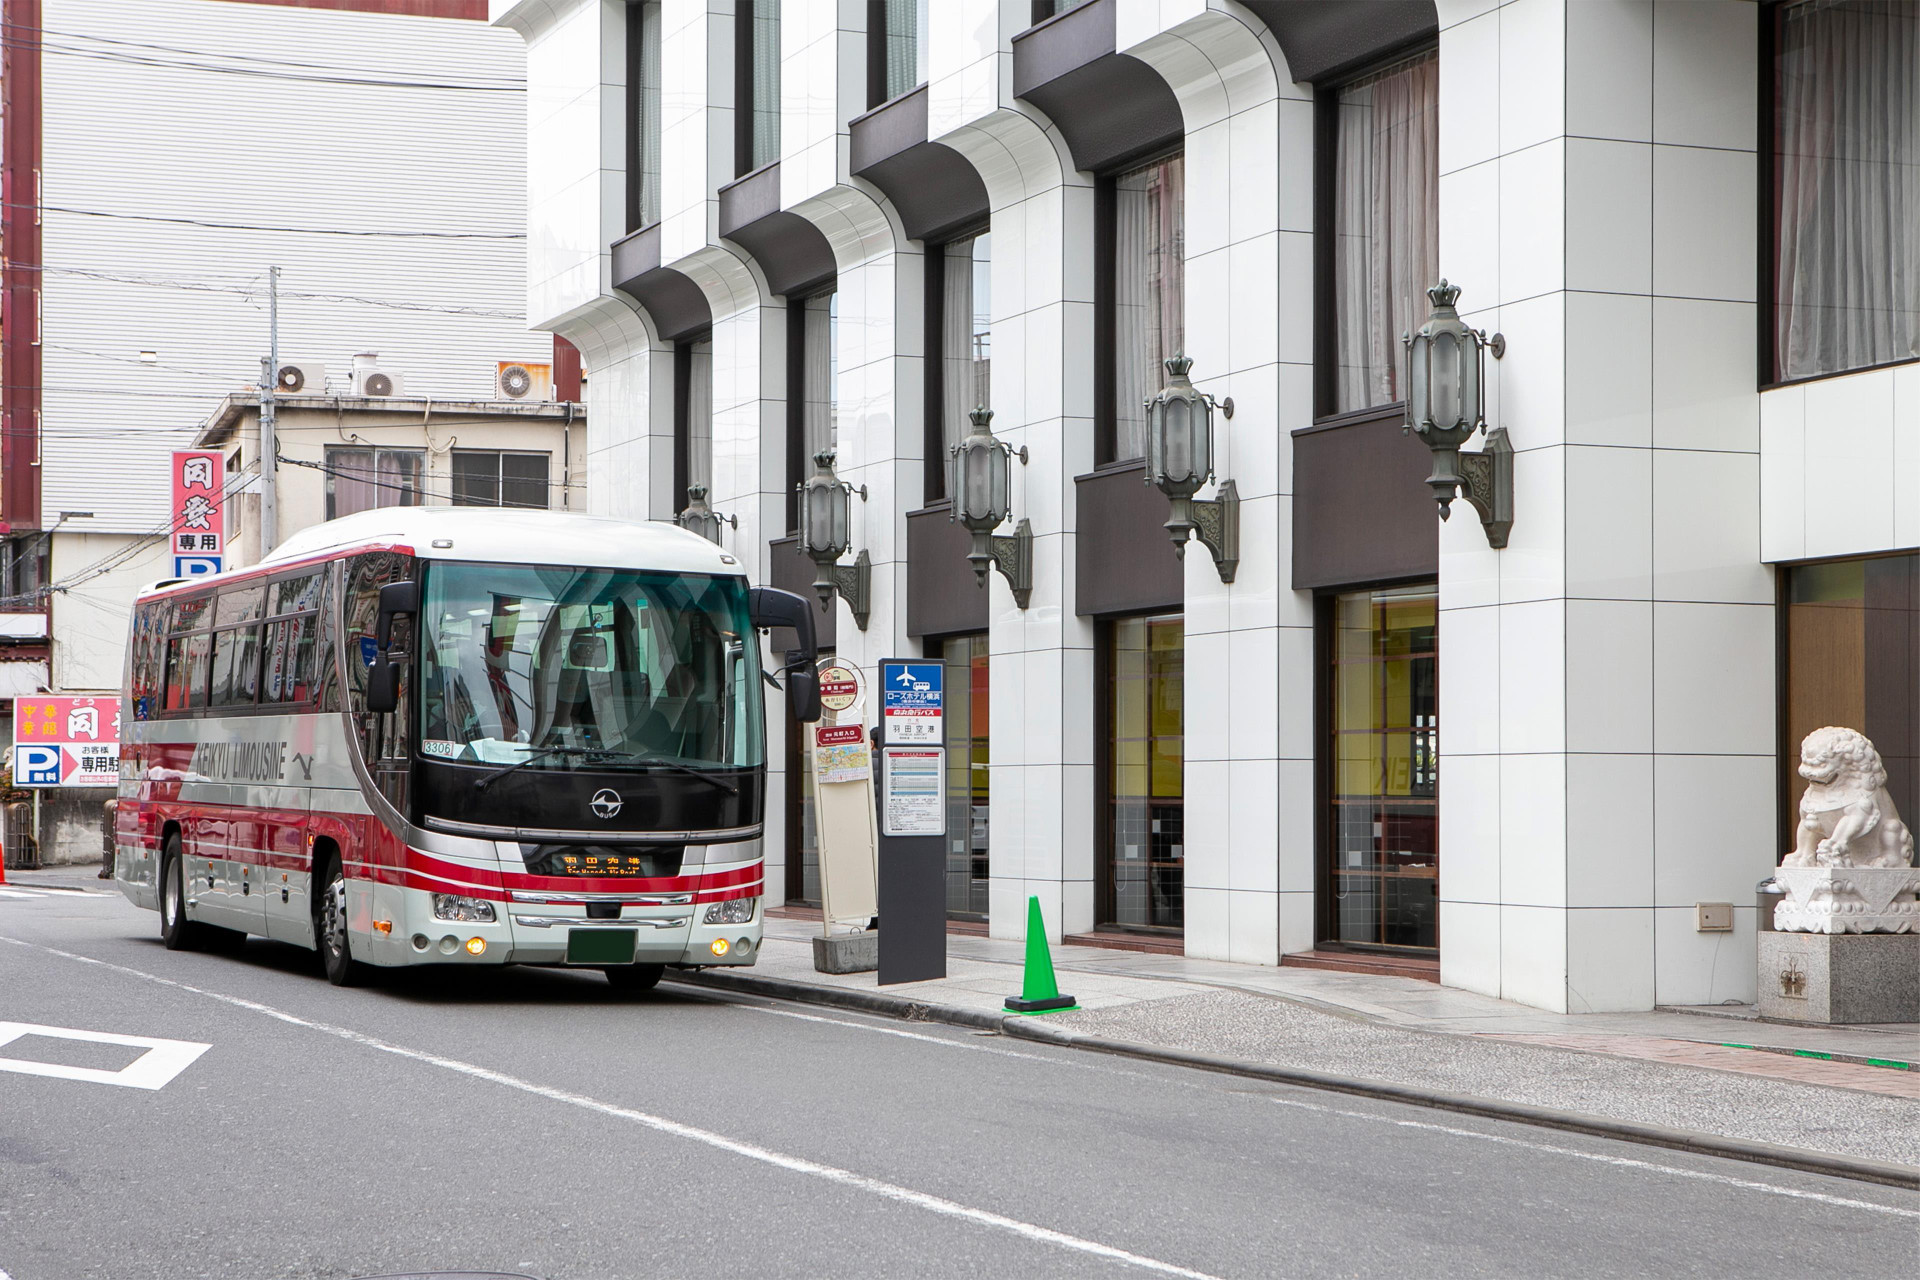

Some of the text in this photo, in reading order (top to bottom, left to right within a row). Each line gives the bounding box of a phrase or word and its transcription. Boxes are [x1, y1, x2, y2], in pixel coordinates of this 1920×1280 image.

[179, 534, 217, 551] 専用
[180, 558, 218, 579] P
[887, 693, 941, 701] ローズホテル横浜
[893, 724, 935, 734] 羽田空港
[82, 747, 109, 755] お客様
[425, 742, 451, 754] 3306
[17, 747, 59, 783] P
[81, 757, 120, 773] 専用駐
[196, 741, 287, 781] KEIKYU LIMOUSINE
[33, 772, 57, 782] 無料
